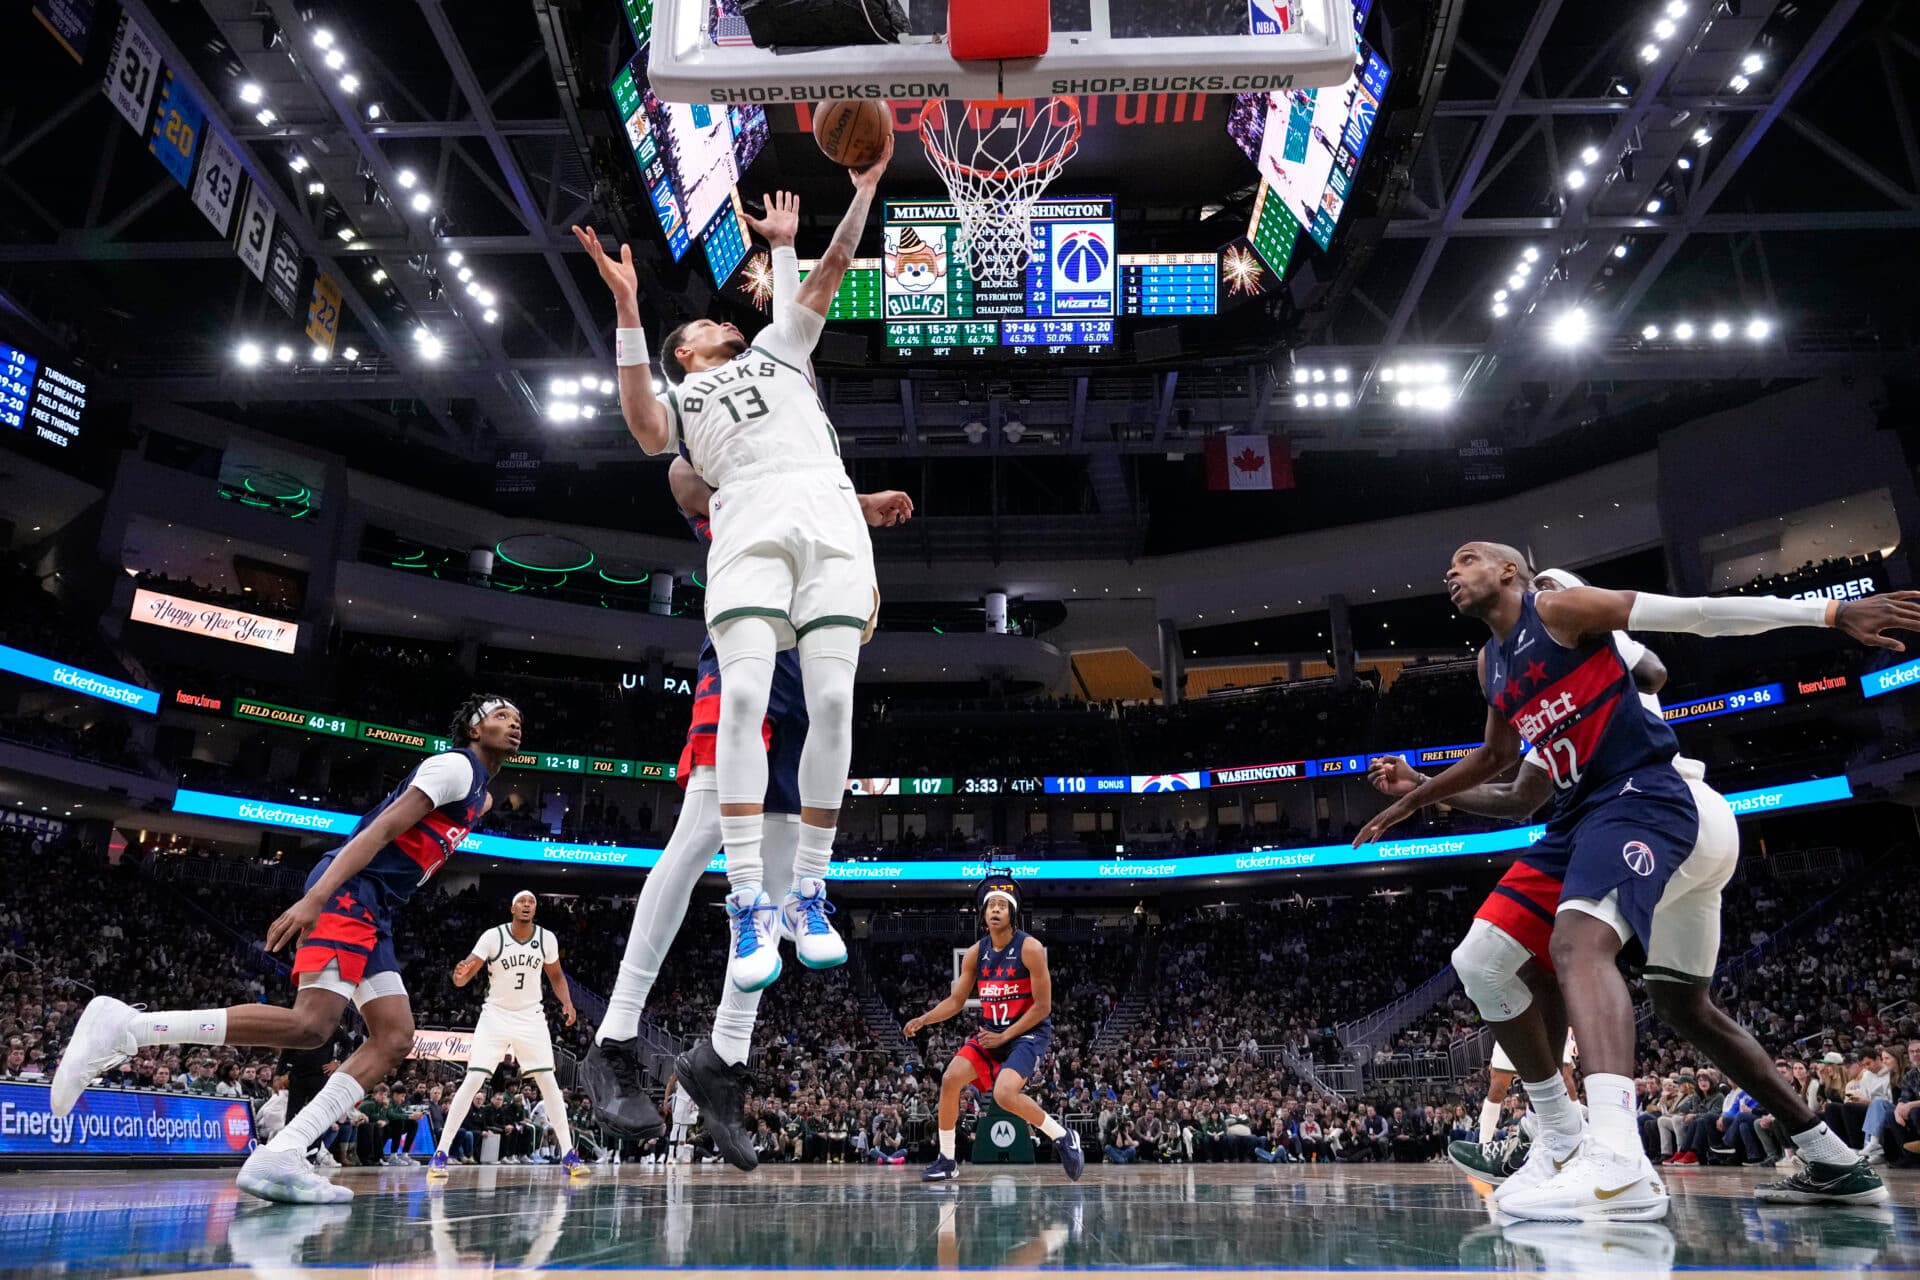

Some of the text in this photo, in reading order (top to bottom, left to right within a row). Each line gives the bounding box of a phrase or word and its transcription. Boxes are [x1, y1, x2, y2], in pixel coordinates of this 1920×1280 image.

[1256, 21, 1277, 34] NBA
[120, 47, 150, 108] 31
[1052, 74, 1294, 94] SHOP.BUCKS.COM
[710, 83, 950, 102] SHOP.BUCKS.COM
[165, 109, 194, 157] 20
[1345, 121, 1364, 151] 110
[639, 135, 656, 163] 107
[206, 164, 232, 208] 43
[1330, 167, 1347, 195] 107
[655, 180, 671, 207] 110
[1017, 205, 1103, 217] SHINGTON
[250, 211, 266, 252] 3
[1034, 226, 1045, 236] 13
[274, 247, 298, 293] 22
[956, 266, 1043, 277] 2 7
[956, 280, 963, 289] 5
[1036, 279, 1043, 289] 6
[888, 294, 944, 315] BUCKS
[956, 292, 1046, 302] 4 PTS FROM TOV 23
[1057, 295, 1109, 309] wizards
[317, 295, 336, 334] 22
[957, 305, 1042, 315] 1 CHALLENGES 1
[890, 322, 1110, 334] 40-81 15-37 12-18 39-86 19-38 13-20
[894, 333, 1109, 345] 49.4% 40.5% 66.7% 45.3% 50.0% 65.0%
[934, 348, 951, 356] 3PT
[973, 347, 985, 355] FT
[1014, 347, 1027, 355] FG
[1049, 346, 1065, 354] 3PT
[11, 351, 86, 394] 10 TURNOVERS
[8, 365, 86, 408] 17 FAST BREAK PTS
[684, 362, 776, 412] BUCKS
[37, 393, 58, 410] FIELD
[57, 403, 81, 421] GOALS
[719, 385, 770, 423] 13
[31, 407, 50, 423] FREE
[51, 416, 80, 436] THROWS
[36, 425, 69, 447] THREES
[150, 599, 197, 628] Happy
[200, 610, 235, 631] New
[53, 667, 143, 705] ticketmaster
[622, 673, 692, 695] URA
[1690, 700, 1725, 715] GOALS
[1729, 690, 1771, 708] 39-86
[239, 703, 676, 777] FIELD GOALS 40-81 3-POINTERS 15- 12-18 TOL 3 FLS 5
[1217, 751, 1444, 784] WASHINGTON FLS 0 FREE
[912, 777, 1124, 794] 107 3:33 4TH 110 BONUS
[238, 803, 334, 829] ticketmaster
[543, 846, 628, 863] ticketmaster
[1378, 840, 1465, 858] ticketmaster
[827, 864, 903, 878] ticketmaster
[1099, 863, 1177, 875] ticketmaster
[1235, 852, 1315, 869] ticketmaster
[501, 954, 541, 970] BUCKS
[514, 973, 525, 990] 3
[990, 1003, 1010, 1026] 12
[1, 1102, 250, 1144] Energy you can depend on we
